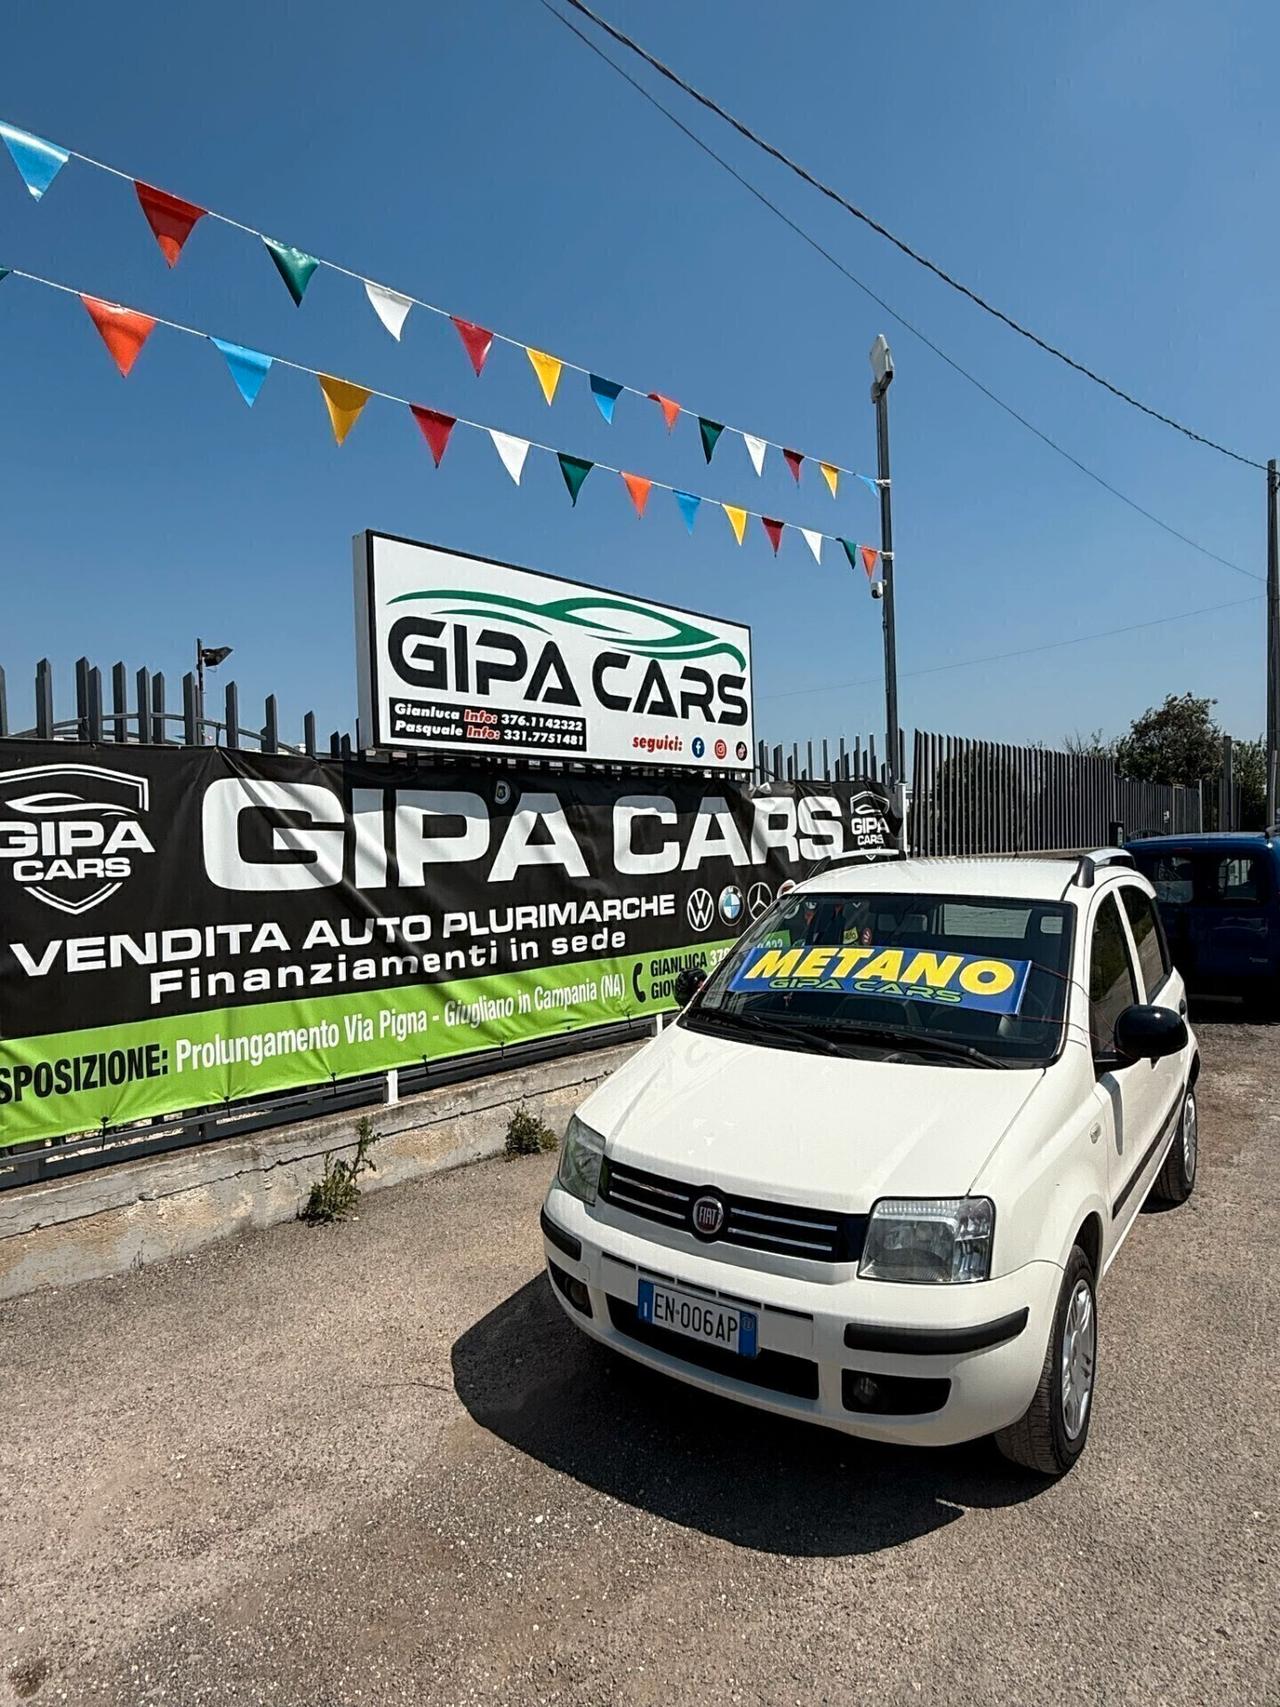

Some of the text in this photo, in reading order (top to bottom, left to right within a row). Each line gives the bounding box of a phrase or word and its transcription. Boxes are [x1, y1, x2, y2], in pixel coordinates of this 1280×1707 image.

[387, 616, 748, 726] GIPA CARS
[394, 703, 583, 731] Gianluca Info: 376.1142322
[395, 720, 584, 745] Pasquale Info: 331.7751481
[632, 735, 683, 752] seguici:
[0, 820, 155, 858] GIPA
[202, 778, 844, 891] GIPA CARS
[851, 817, 890, 835] GIPA
[857, 834, 884, 846] CARS
[13, 857, 131, 882] CARS
[10, 894, 676, 977] VENDITA AUTO PLURIMARCHE
[150, 927, 626, 1004] Finanziamenti in sede
[651, 952, 707, 976] GIANLUCA
[744, 946, 1014, 996] METANO
[769, 976, 963, 1004] GIPA CARS
[176, 1021, 340, 1073] Prolungamento
[344, 1014, 373, 1043] Via
[380, 1007, 427, 1040] Pigna
[444, 998, 513, 1029] Giugliano
[518, 994, 531, 1013] in
[534, 982, 597, 1011] Campania
[600, 973, 626, 1002] (NA)
[699, 1206, 717, 1225] FIAT
